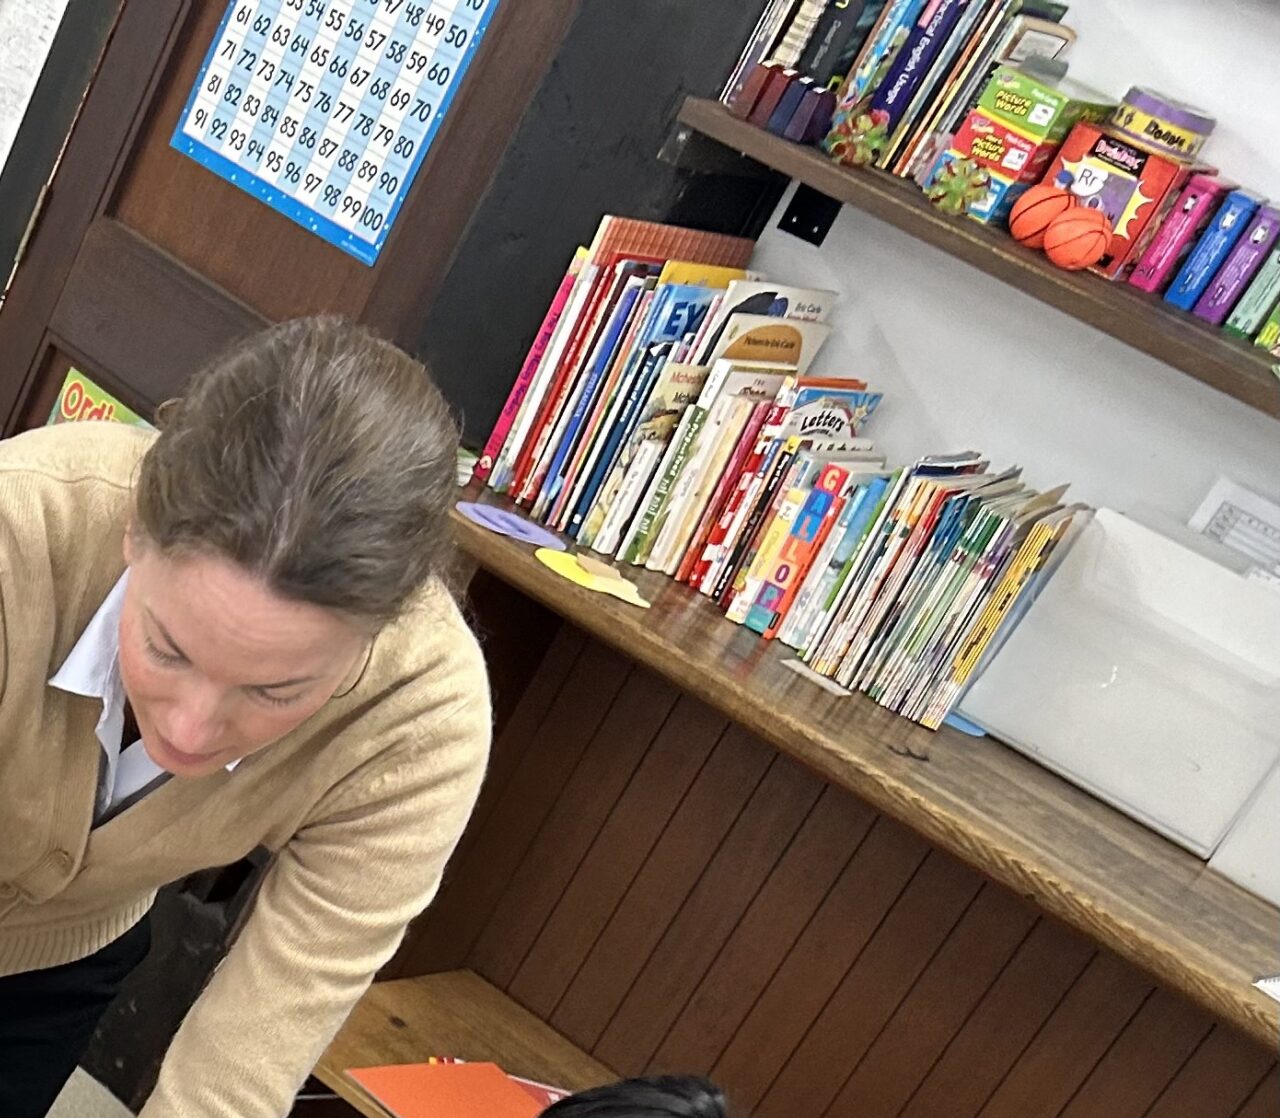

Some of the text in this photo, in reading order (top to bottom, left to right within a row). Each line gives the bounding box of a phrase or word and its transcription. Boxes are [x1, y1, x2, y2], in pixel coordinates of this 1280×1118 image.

[306, 0, 325, 20] 54
[326, 9, 345, 30] 55
[345, 19, 364, 41] 56
[365, 30, 386, 50] 57
[386, 41, 407, 63] 58
[407, 51, 427, 73] 59
[428, 63, 449, 85] 60
[406, 3, 425, 26] 48
[427, 14, 445, 35] 49
[445, 25, 467, 48] 50
[237, 6, 431, 122] 61 62 63 64 65 66 67 68 69 70
[903, 35, 929, 72] English
[222, 40, 414, 158] 71 72 73 74 75 76 77 78 79 80
[885, 72, 907, 105] Usage
[995, 99, 1028, 116] Words
[996, 90, 1032, 107] Picture
[208, 75, 397, 195] 81 82 83 84 85 86 87 88 89 90
[195, 109, 383, 231] 91 92 93 94 95 96 97 98 99 100
[1078, 168, 1099, 187] Rr
[800, 411, 844, 432] Letters
